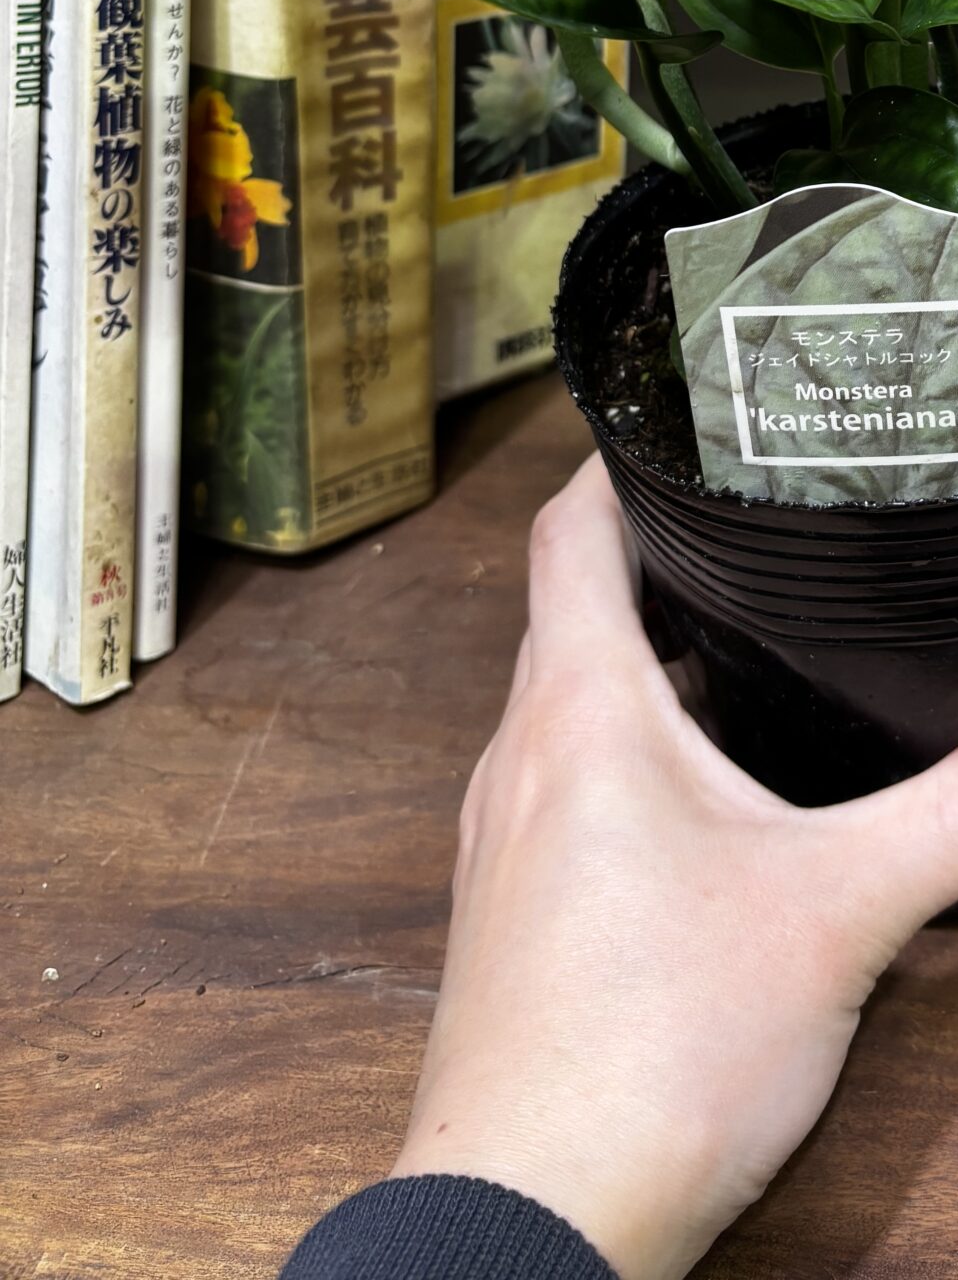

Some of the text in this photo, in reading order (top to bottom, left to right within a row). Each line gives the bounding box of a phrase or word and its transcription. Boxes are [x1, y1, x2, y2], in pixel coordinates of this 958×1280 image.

[15, 3, 42, 108] INTERIOR
[791, 328, 904, 347] モンステラ
[748, 347, 952, 368] ジェイドシャトルコック
[795, 382, 913, 402] Monstera
